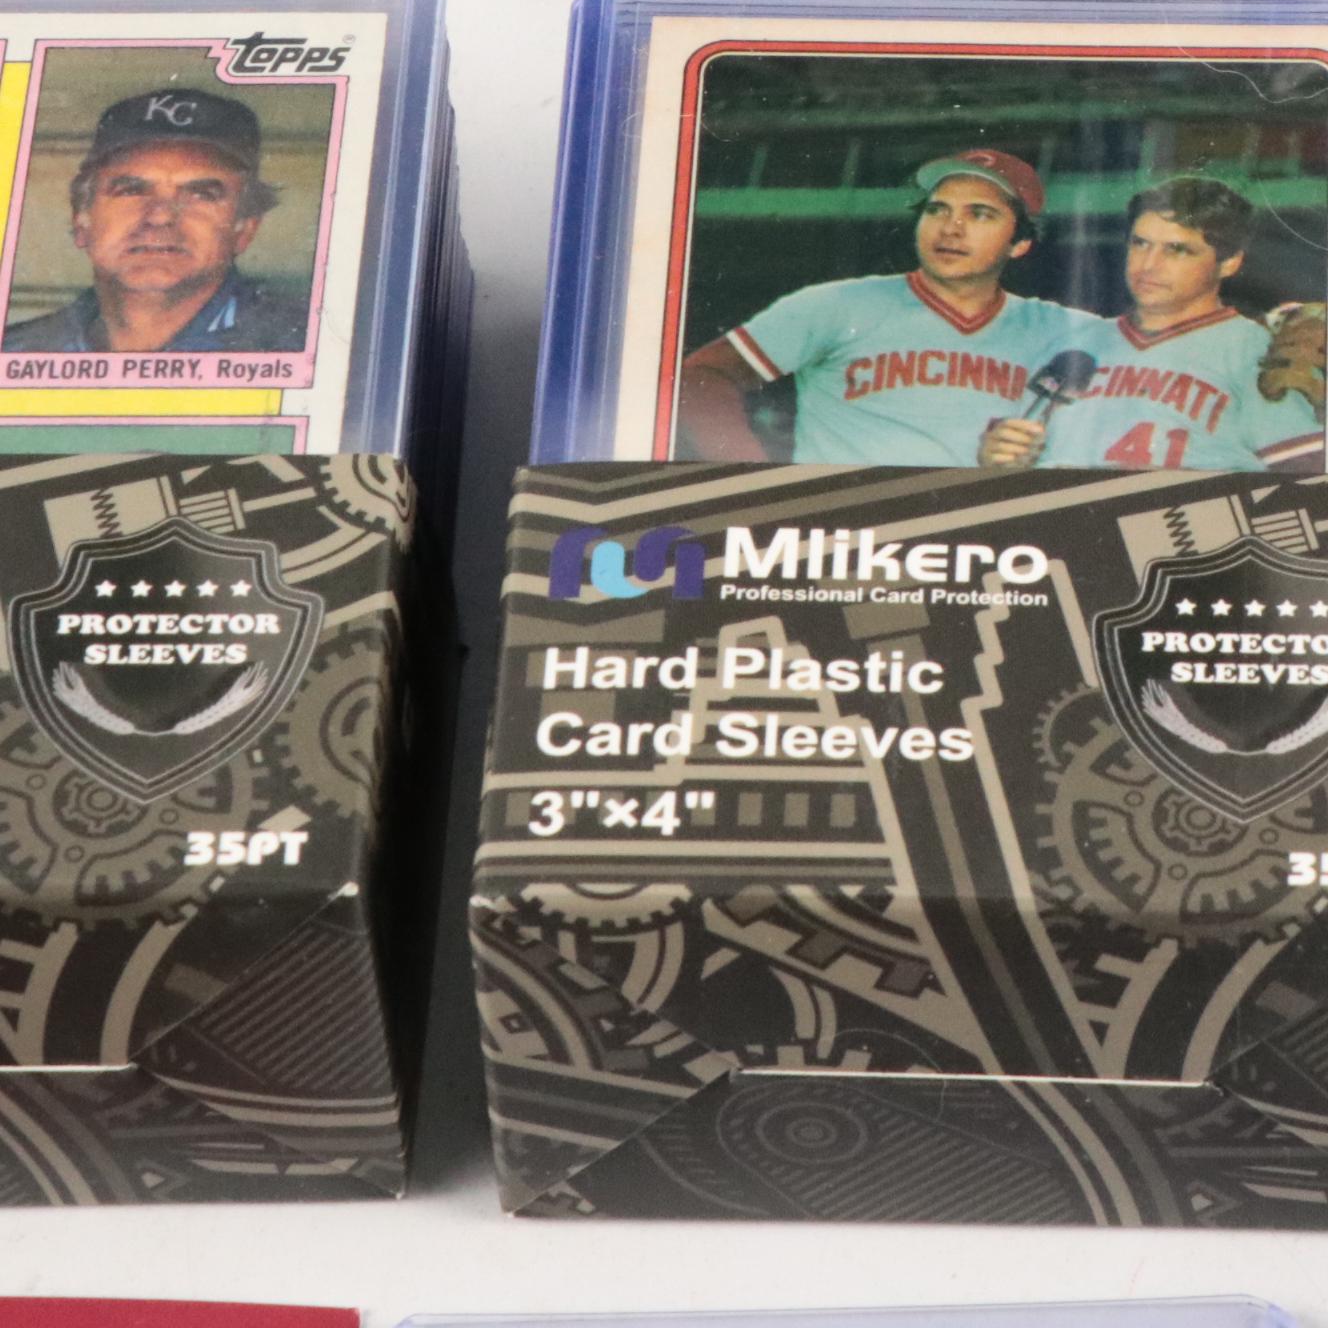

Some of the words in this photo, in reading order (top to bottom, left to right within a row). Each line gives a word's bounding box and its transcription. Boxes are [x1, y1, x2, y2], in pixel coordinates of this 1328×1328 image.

[145, 94, 198, 126] KC
[6, 358, 109, 380] GAYLORD
[122, 357, 204, 381] PERRY,
[217, 357, 294, 383] Royals
[1104, 421, 1190, 470] 41
[723, 526, 1049, 584] Mlikero
[720, 584, 863, 603] Professional
[870, 587, 927, 604] Card
[931, 588, 1048, 606] Protection
[57, 613, 280, 635] PROTECTOR
[84, 643, 247, 665] SLEEVES
[543, 647, 698, 689] Hard
[722, 647, 944, 694] Plastic
[537, 712, 694, 757] Card
[716, 716, 975, 762] Sleeves
[184, 830, 308, 866] 35PT
